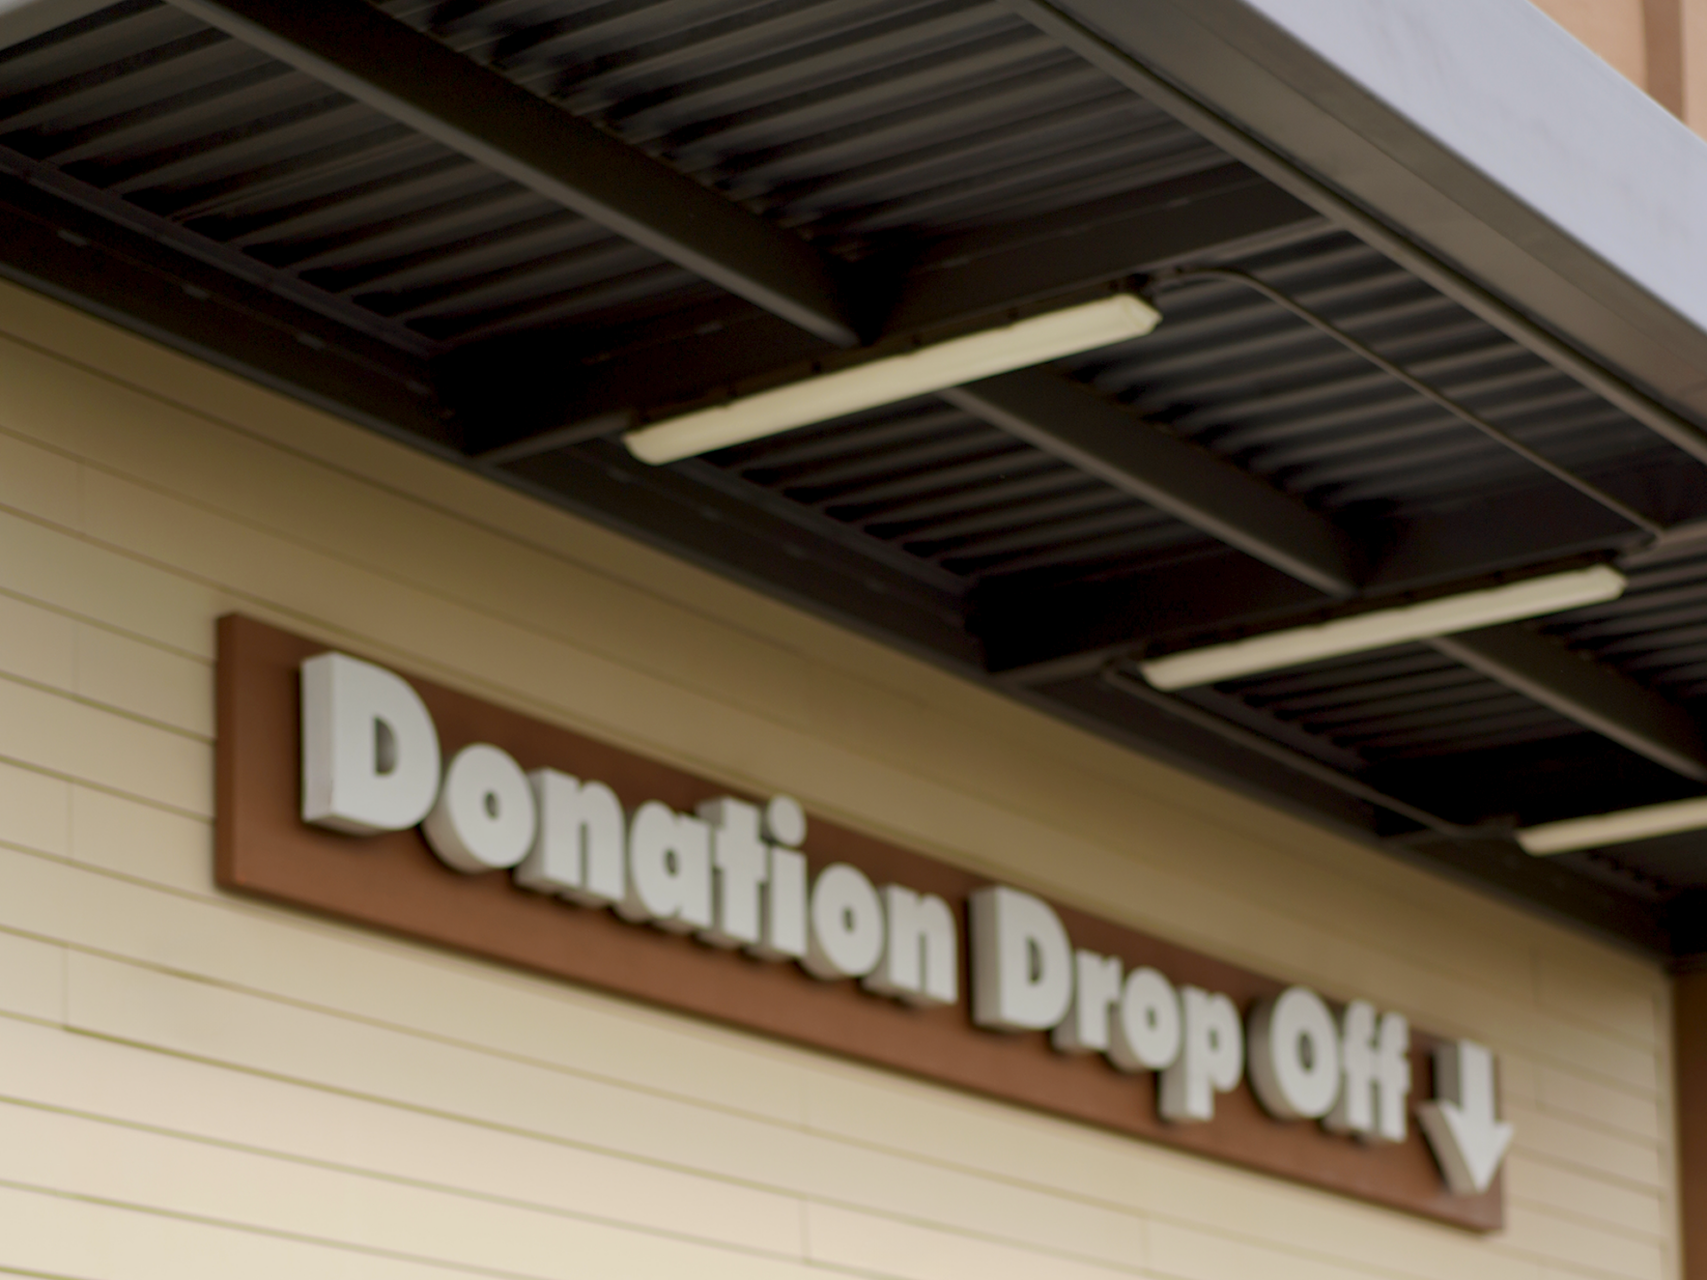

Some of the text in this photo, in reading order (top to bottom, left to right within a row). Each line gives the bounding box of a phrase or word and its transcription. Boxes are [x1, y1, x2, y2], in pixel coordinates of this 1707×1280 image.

[303, 652, 1411, 1143] Donation Drop Off
